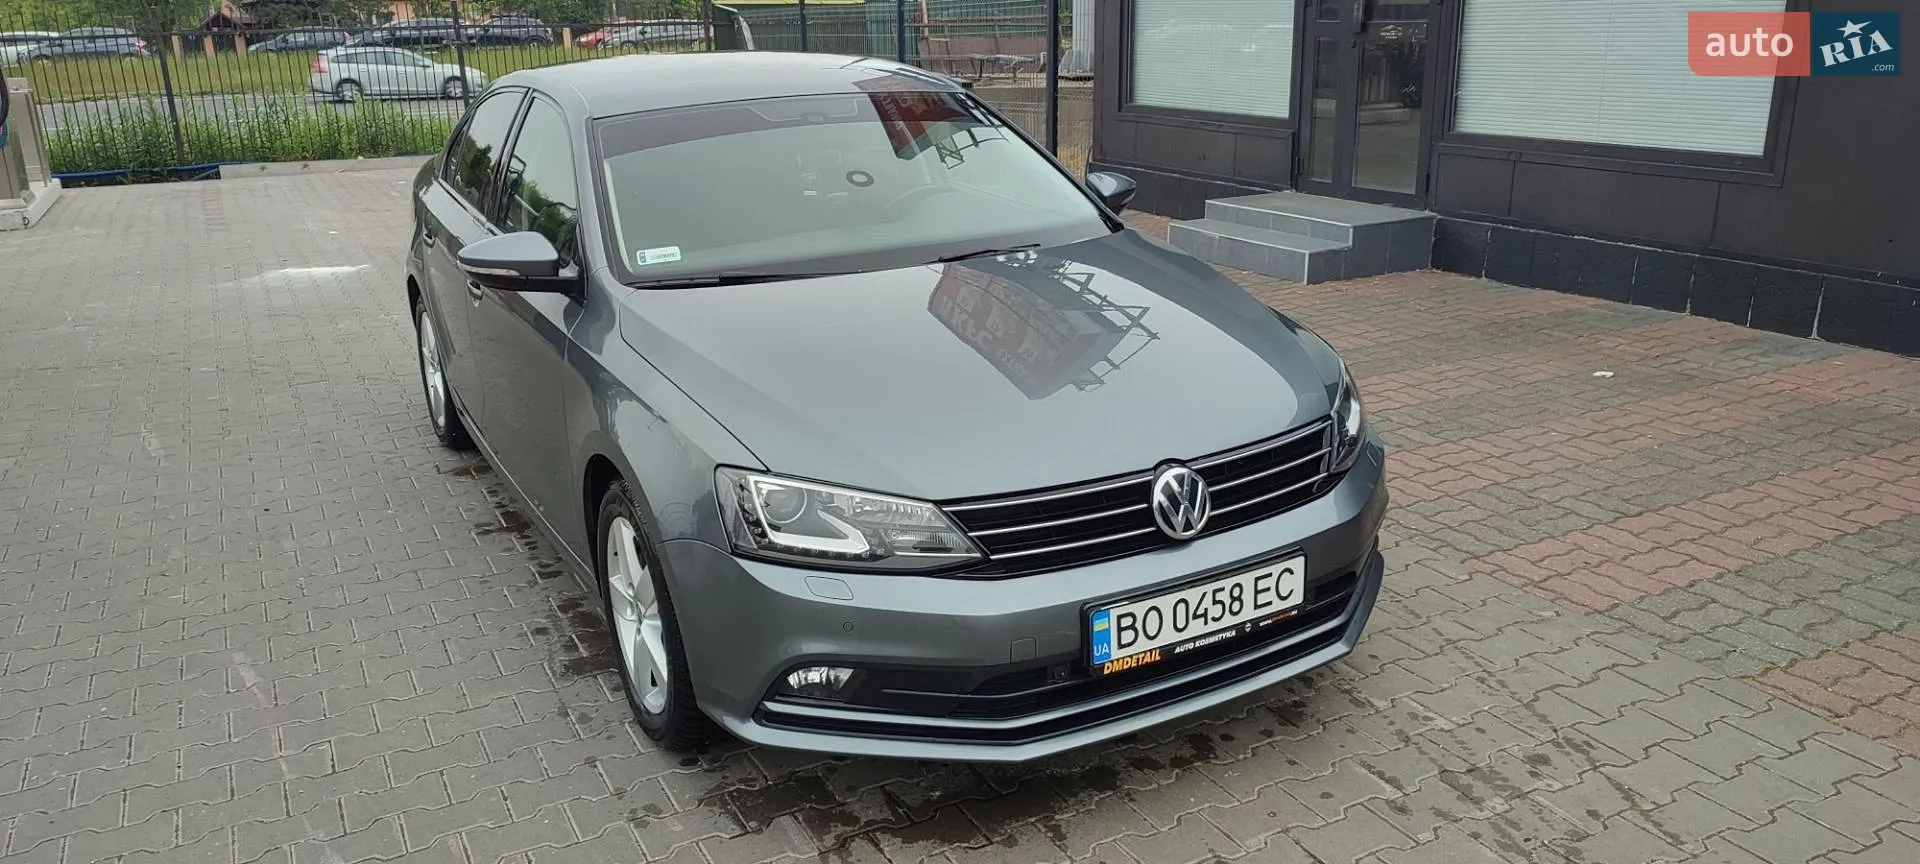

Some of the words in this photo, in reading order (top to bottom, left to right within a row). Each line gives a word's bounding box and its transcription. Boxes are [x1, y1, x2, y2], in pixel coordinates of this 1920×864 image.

[1116, 605, 1164, 650] BO
[1172, 582, 1244, 633] 0458
[1253, 567, 1295, 610] EC
[1094, 643, 1109, 656] UA
[1174, 641, 1194, 654] AUTO
[1103, 649, 1161, 675] DMDETAIL
